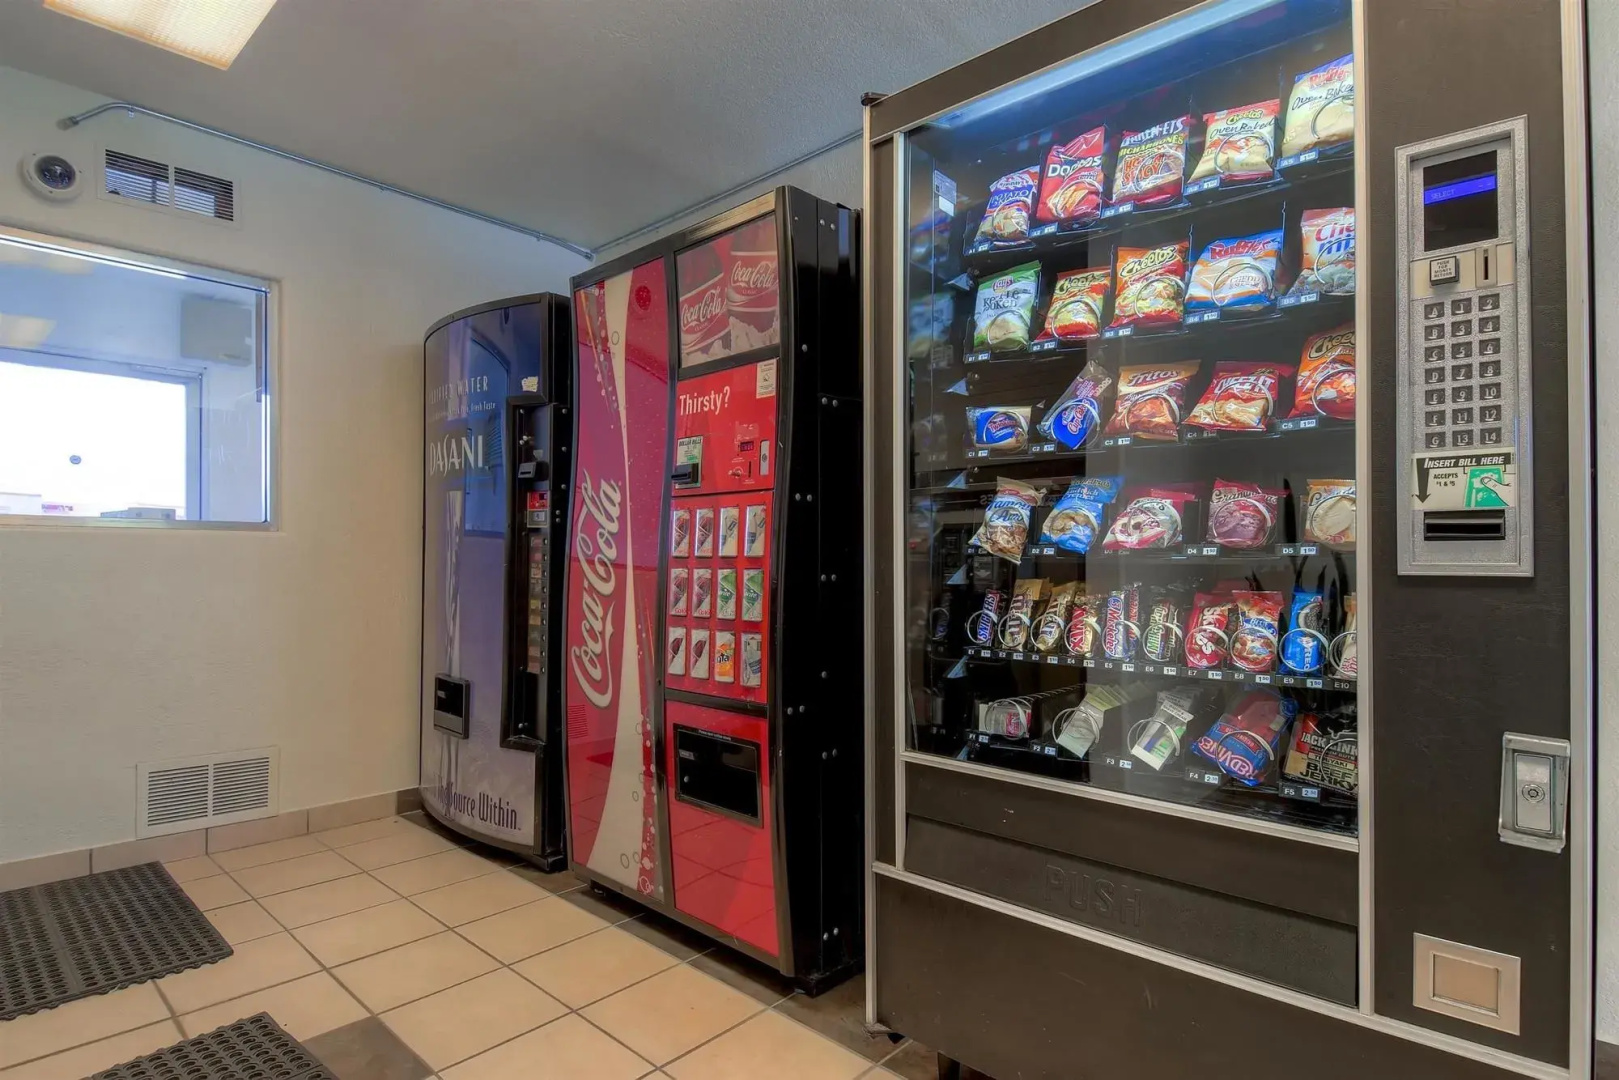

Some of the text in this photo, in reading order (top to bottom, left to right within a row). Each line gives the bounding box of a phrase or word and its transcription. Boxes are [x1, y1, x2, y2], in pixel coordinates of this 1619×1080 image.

[1430, 188, 1456, 200] SELECT
[1120, 245, 1177, 278] Cheetos
[1459, 325, 1465, 333] 3
[1487, 321, 1492, 329] 4
[1460, 347, 1465, 355] 5
[1487, 344, 1493, 352] 6
[1127, 370, 1178, 386] Fritos
[1487, 366, 1493, 374] 8
[457, 376, 488, 397] WATER
[1484, 388, 1496, 396] 10
[680, 386, 731, 415] Thirsty?
[1458, 413, 1467, 421] 11
[1485, 410, 1496, 418] 12
[1432, 432, 1496, 445] G 13 14
[430, 434, 484, 477] DASANI
[1424, 456, 1504, 468] INSERT BILL HERE
[572, 468, 621, 708] Coca-Cola
[979, 594, 998, 640] SNICERS
[1301, 732, 1326, 747] JACK
[1307, 762, 1355, 781] BEEF
[1300, 770, 1356, 791] JERKY
[478, 791, 518, 831] Within
[1044, 863, 1142, 927] PUSH
